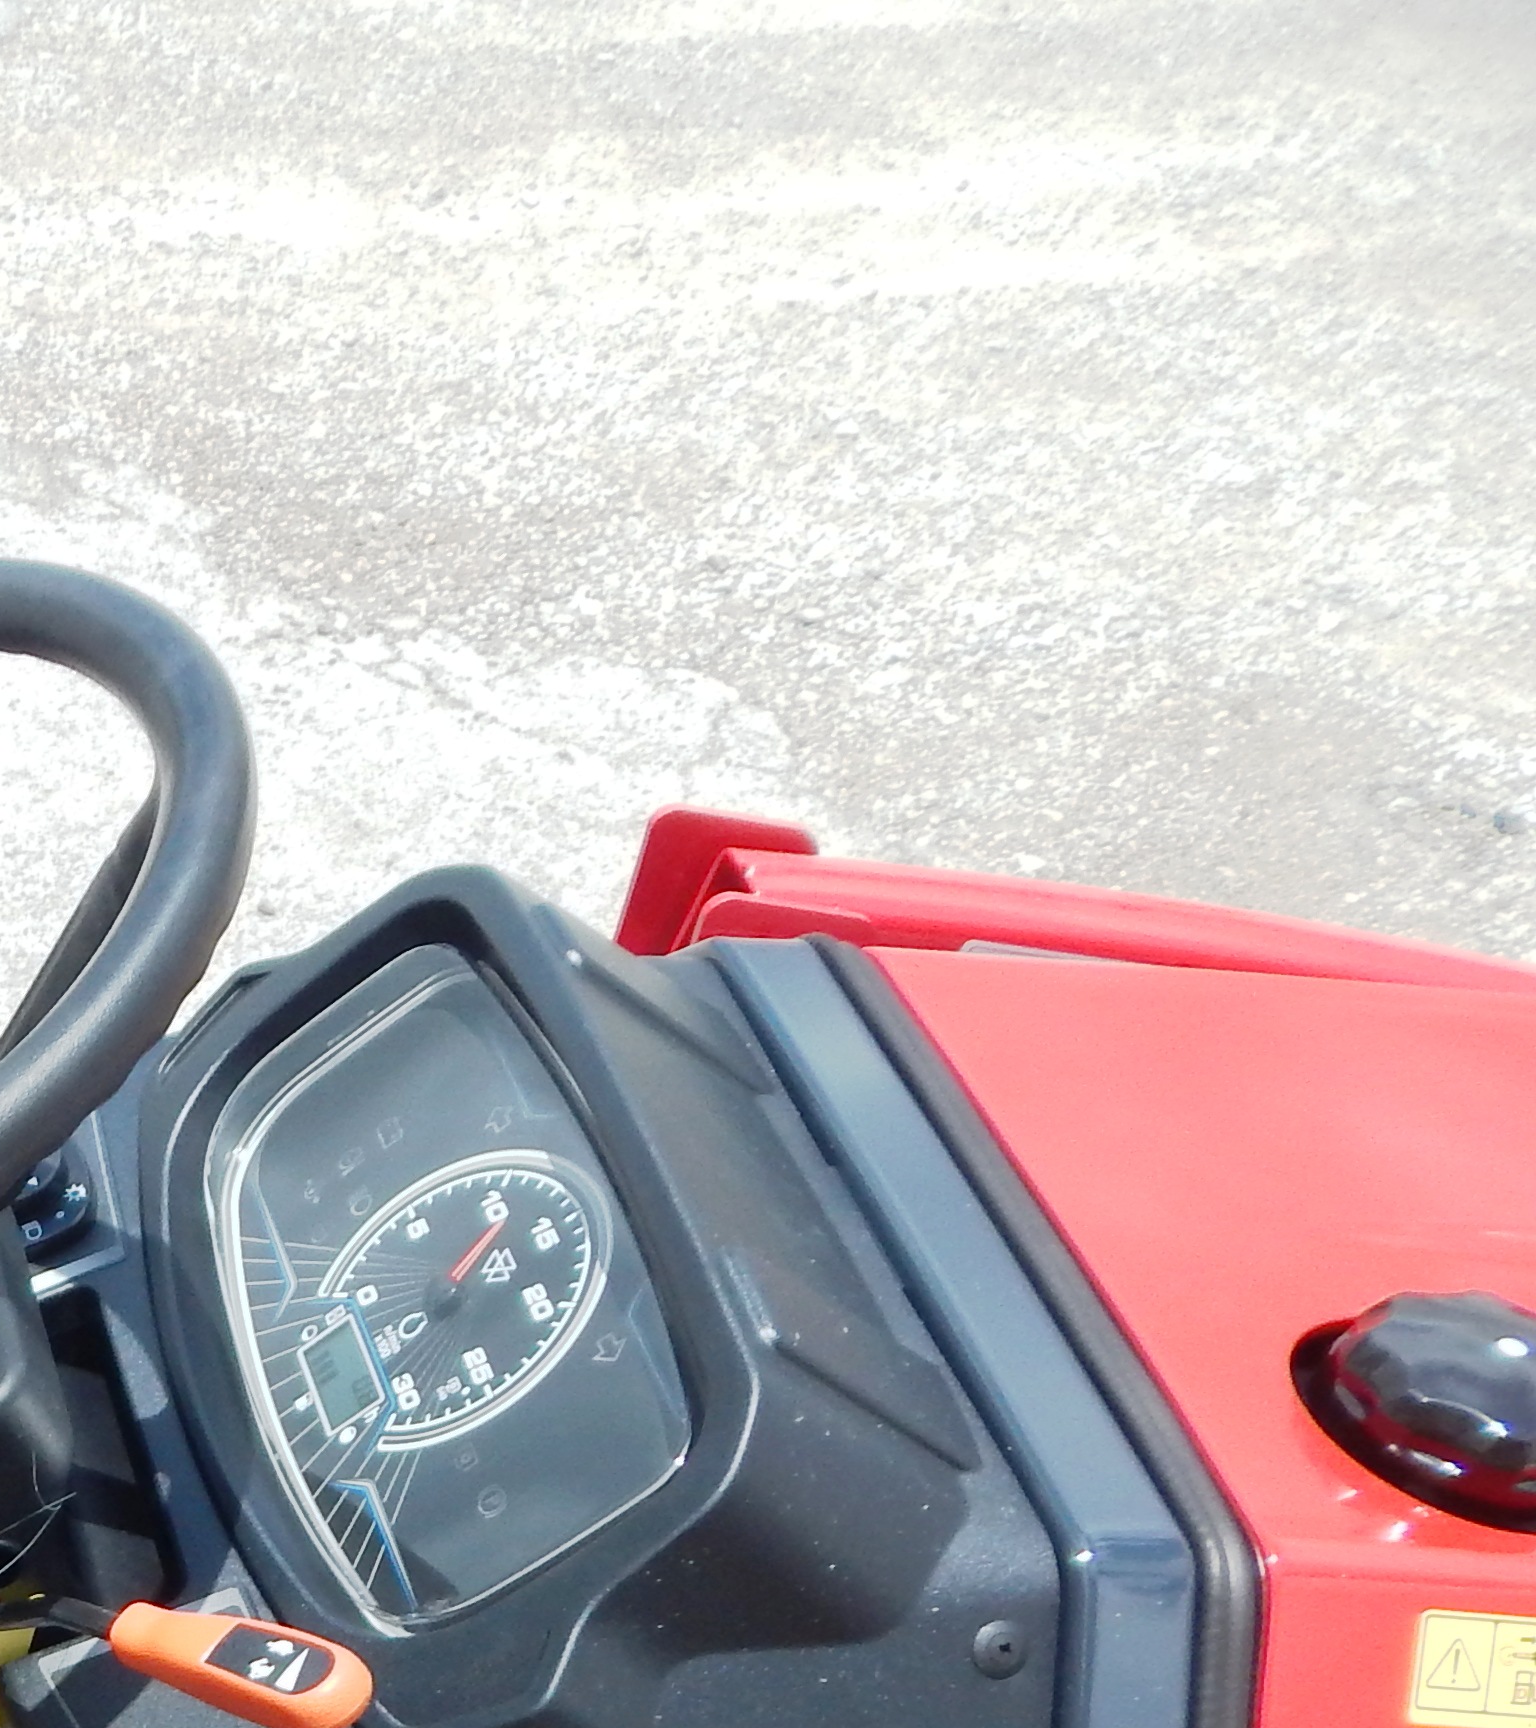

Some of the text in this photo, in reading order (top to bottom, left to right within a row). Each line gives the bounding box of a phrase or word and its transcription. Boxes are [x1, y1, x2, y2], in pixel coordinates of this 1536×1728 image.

[481, 1190, 510, 1223] 10
[406, 1217, 430, 1240] 5
[531, 1217, 561, 1250] 15
[356, 1285, 379, 1306] 0
[522, 1283, 555, 1322] 20
[461, 1346, 495, 1385] 25
[391, 1372, 421, 1411] 30
